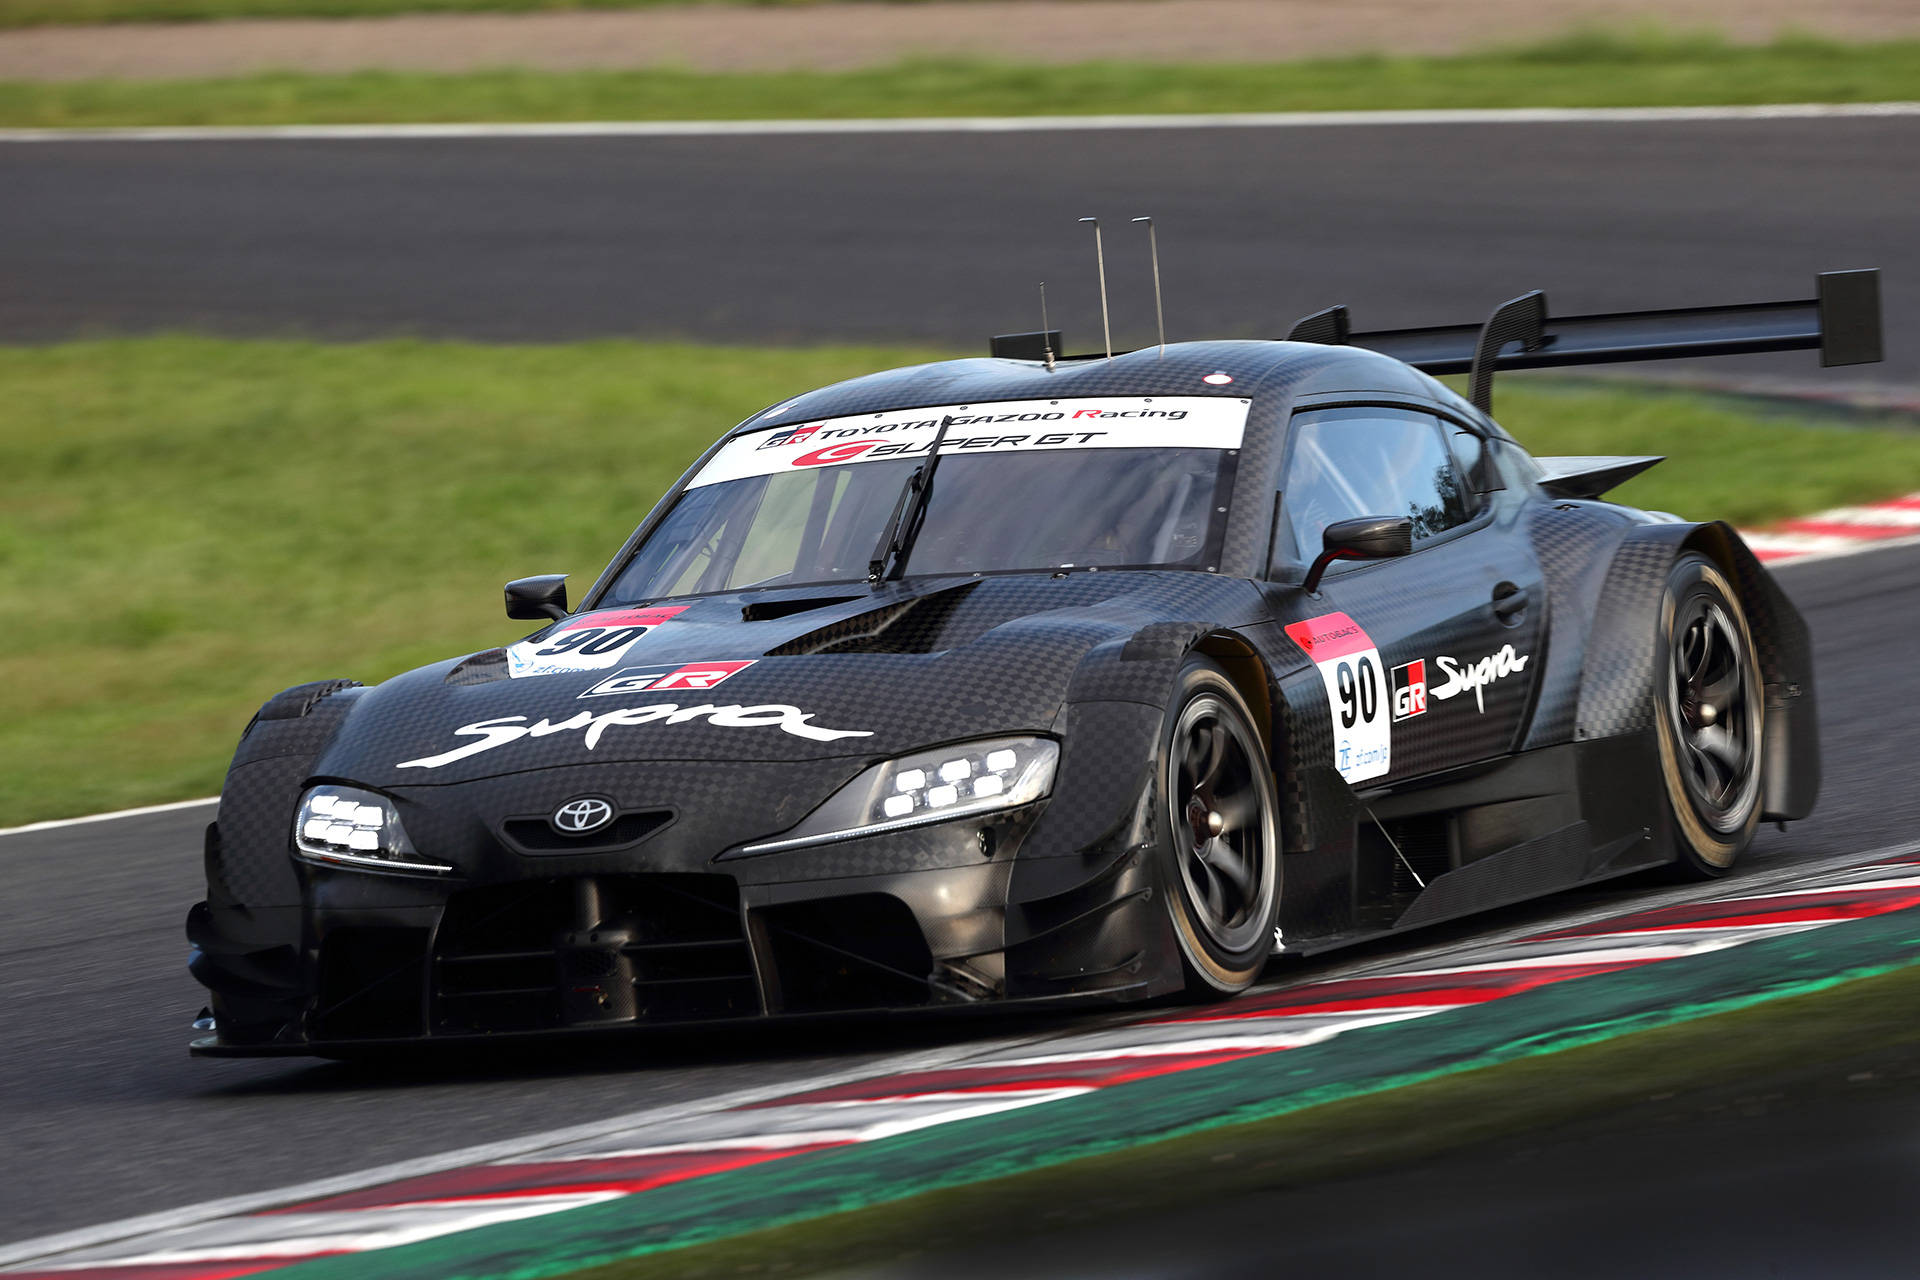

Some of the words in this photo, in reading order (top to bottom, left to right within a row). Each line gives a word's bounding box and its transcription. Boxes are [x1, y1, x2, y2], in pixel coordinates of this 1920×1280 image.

[820, 420, 937, 440] TOYOTA
[948, 413, 1064, 426] GAZOO
[1072, 409, 1188, 420] Racing
[866, 435, 1031, 458] SUPER
[1034, 432, 1108, 445] GT
[536, 627, 648, 656] 90
[591, 671, 728, 693] GR
[1337, 656, 1377, 729] 90
[1429, 644, 1529, 714] Supra
[1395, 682, 1426, 717] GR
[395, 704, 875, 769] Supra
